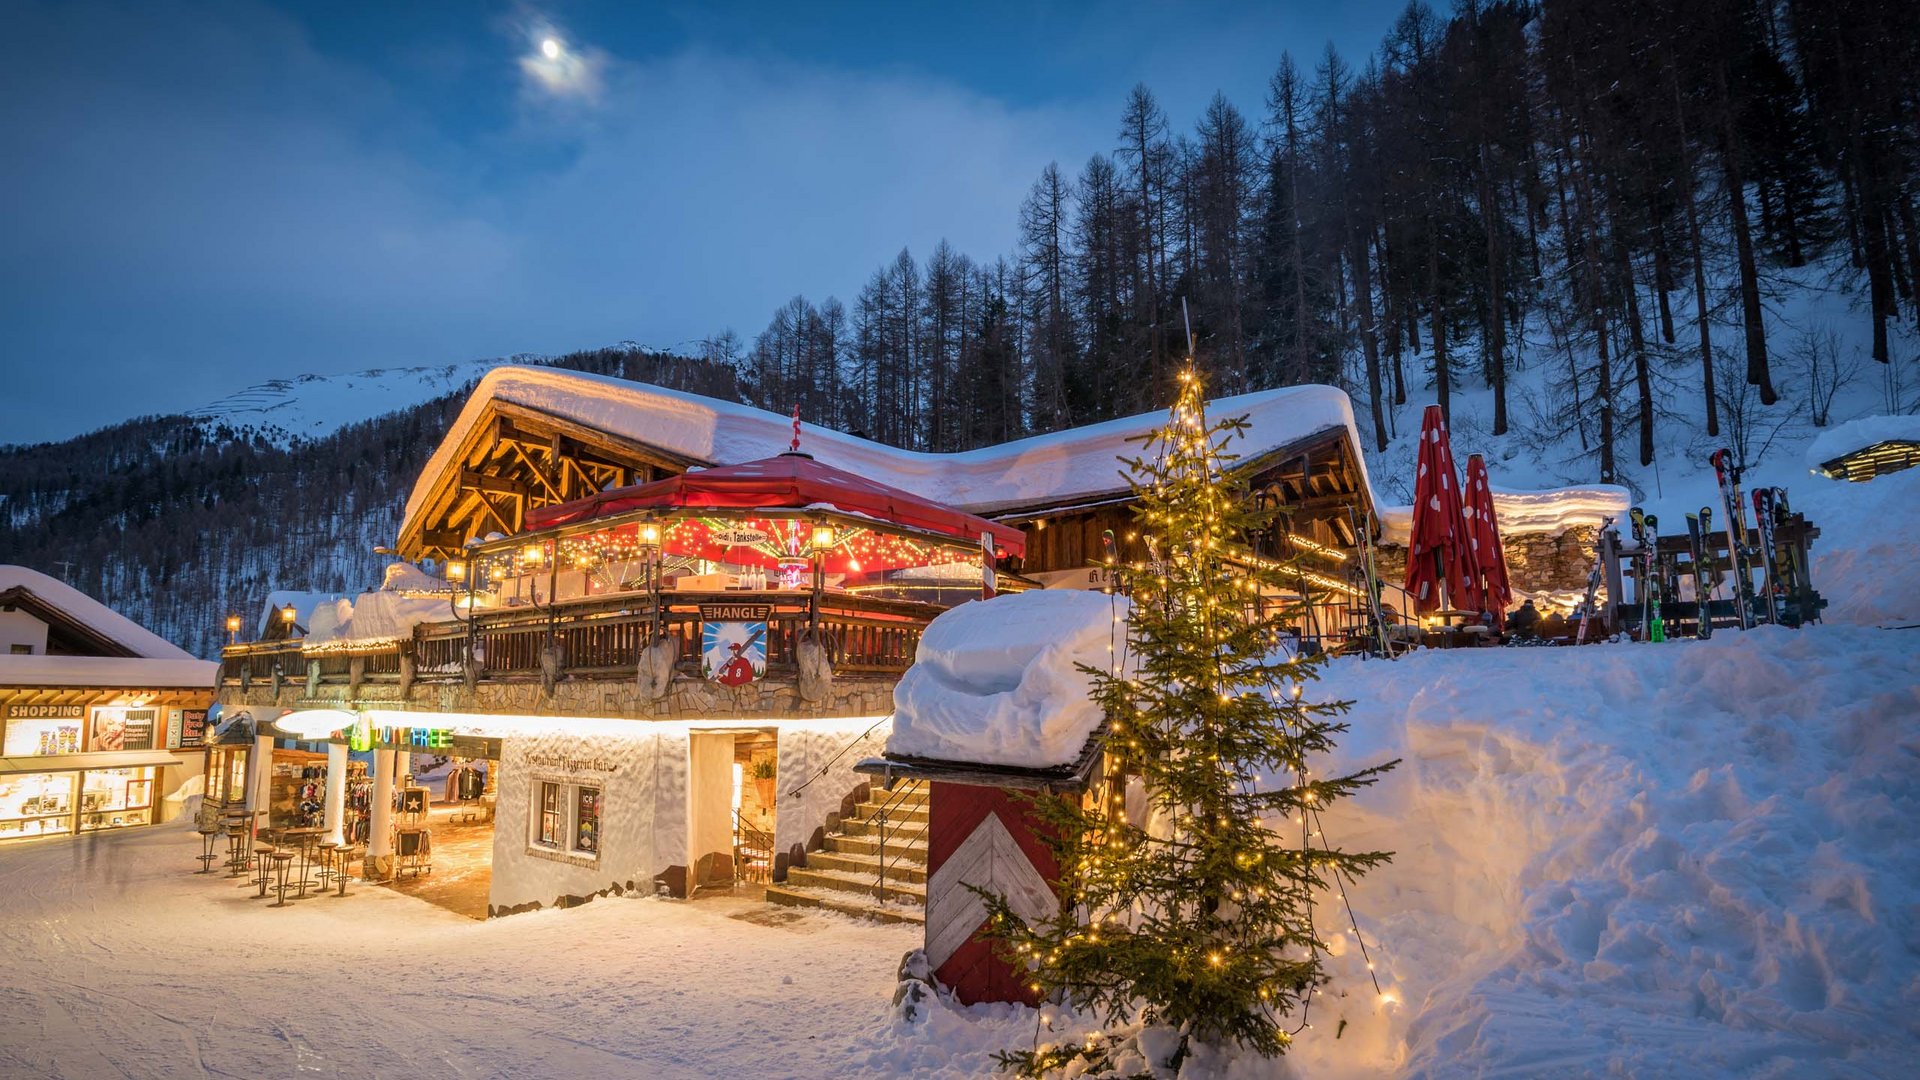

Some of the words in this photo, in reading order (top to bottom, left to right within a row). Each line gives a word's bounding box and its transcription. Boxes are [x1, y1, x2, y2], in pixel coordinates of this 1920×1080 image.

[713, 607, 757, 619] HANGL
[735, 667, 742, 678] 8
[10, 705, 81, 717] SHOPPING
[376, 726, 405, 745] DUTY
[412, 727, 450, 748] FREE
